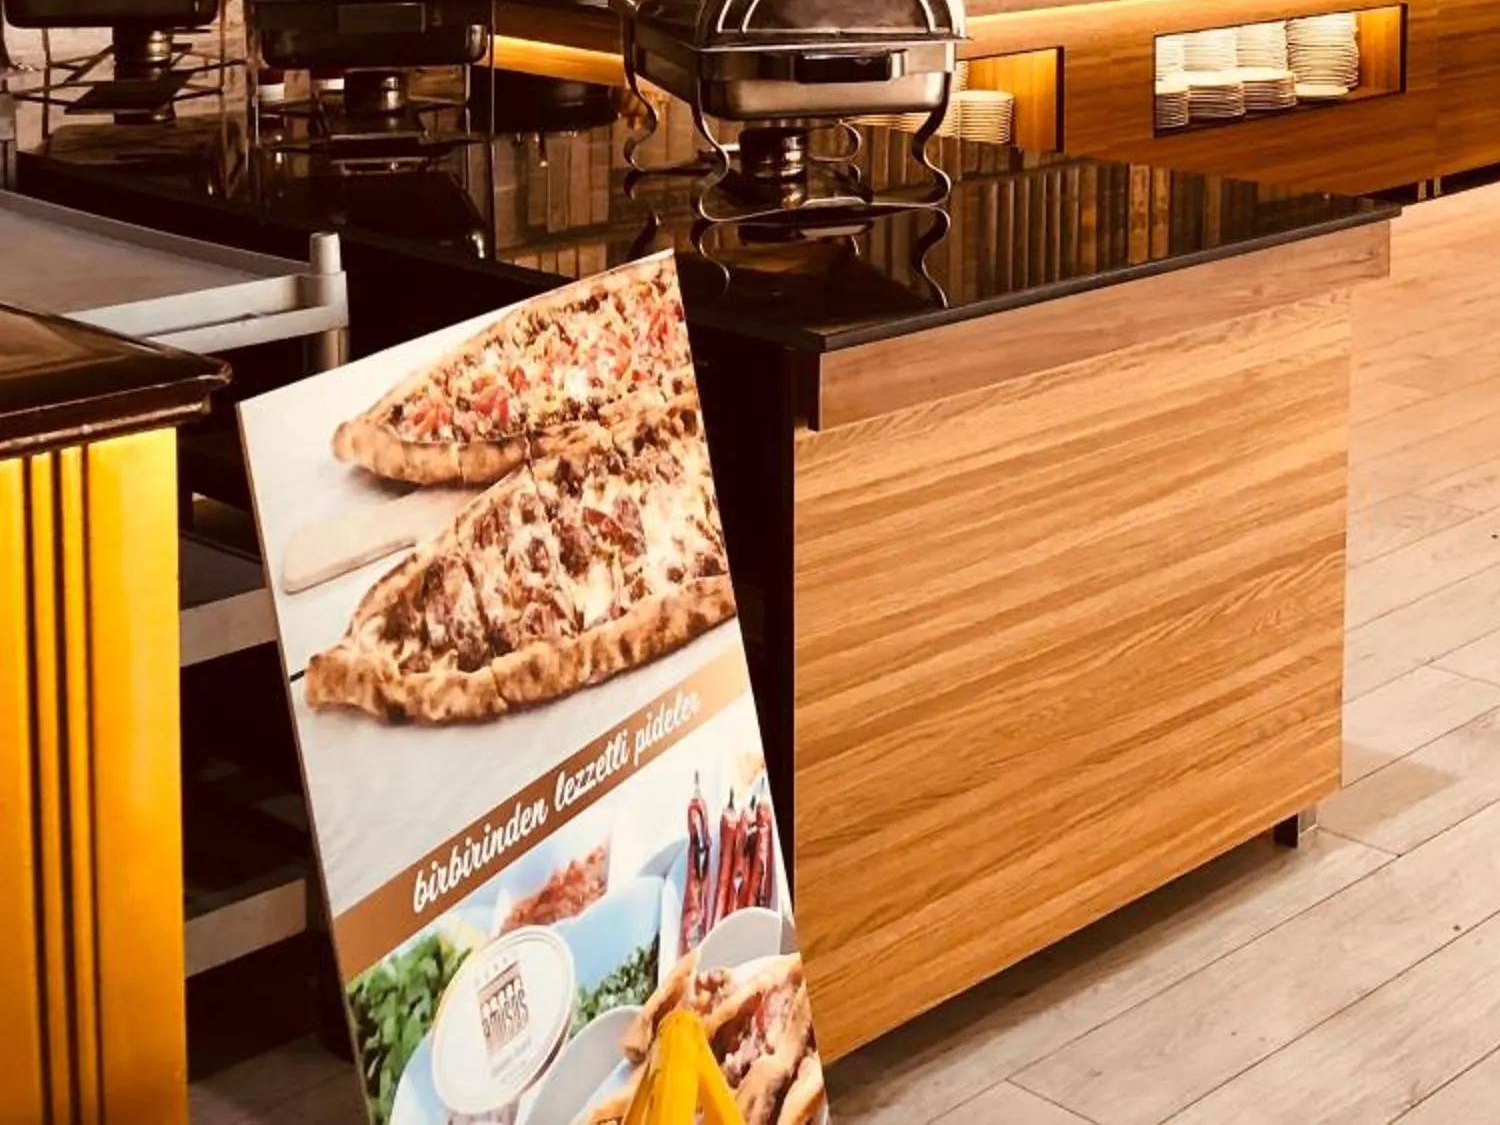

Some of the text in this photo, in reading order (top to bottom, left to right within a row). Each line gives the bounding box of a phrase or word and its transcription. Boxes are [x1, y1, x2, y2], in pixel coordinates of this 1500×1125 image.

[413, 690, 701, 914] birbirinden lezzetli pideler
